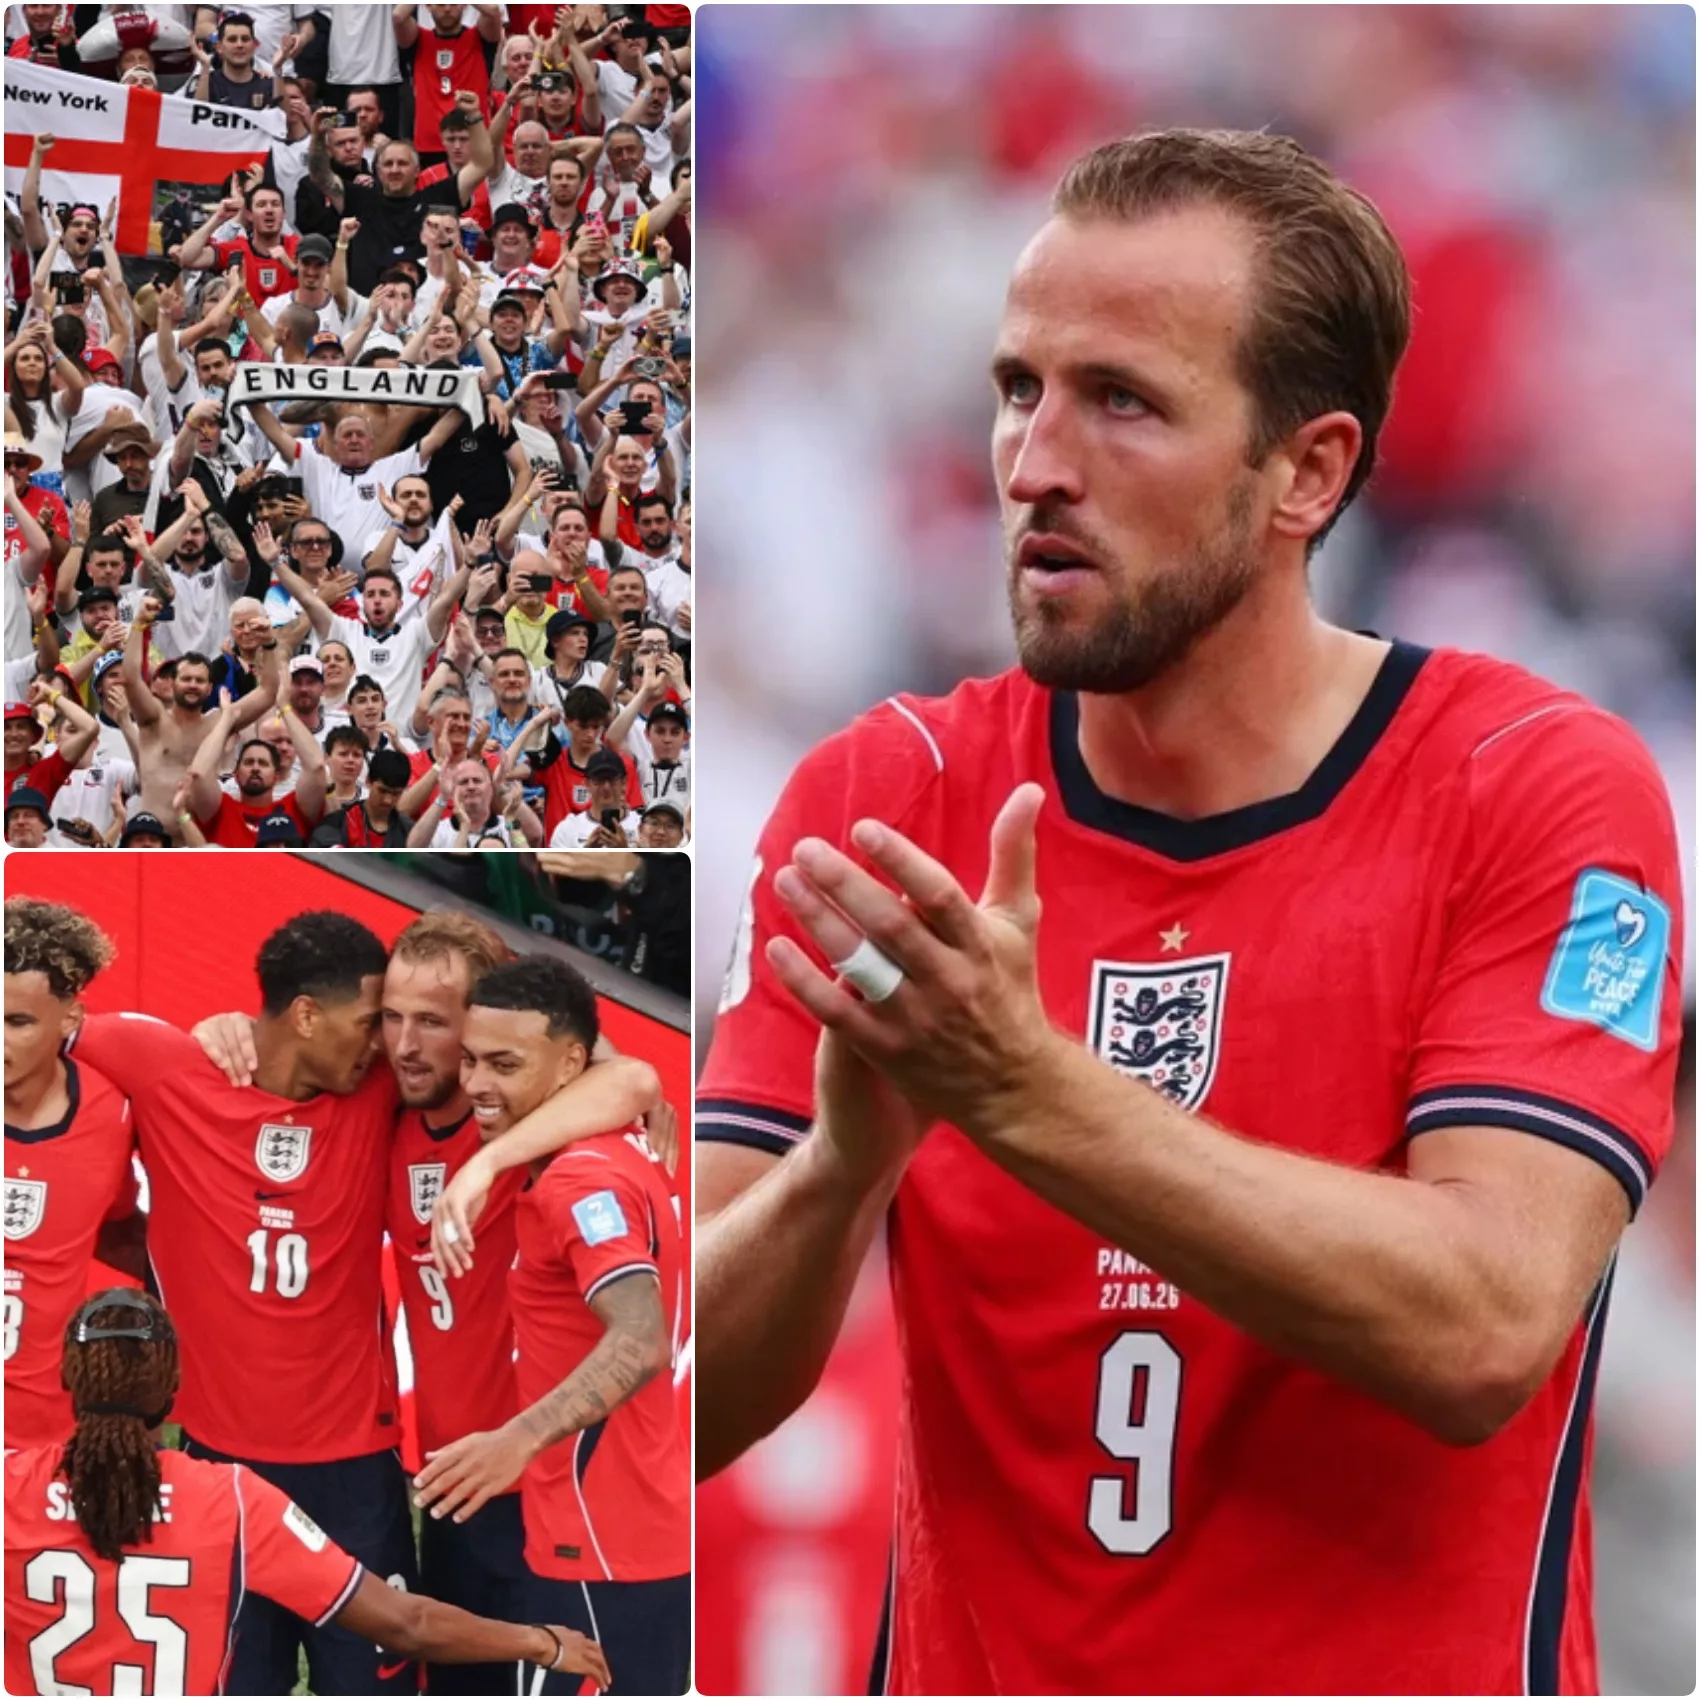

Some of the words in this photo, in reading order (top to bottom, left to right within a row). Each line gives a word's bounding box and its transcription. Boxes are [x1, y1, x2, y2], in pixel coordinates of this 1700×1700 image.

[4, 84, 52, 105] New
[58, 90, 108, 112] York
[191, 104, 259, 130] Par
[244, 368, 459, 397] ENGLAND
[247, 1229, 308, 1298] 10
[1097, 1248, 1153, 1275] PAN
[419, 1265, 454, 1331] 9
[1099, 1282, 1180, 1310] 27.06.26
[1087, 1330, 1183, 1556] 9
[25, 1550, 191, 1696] 25
